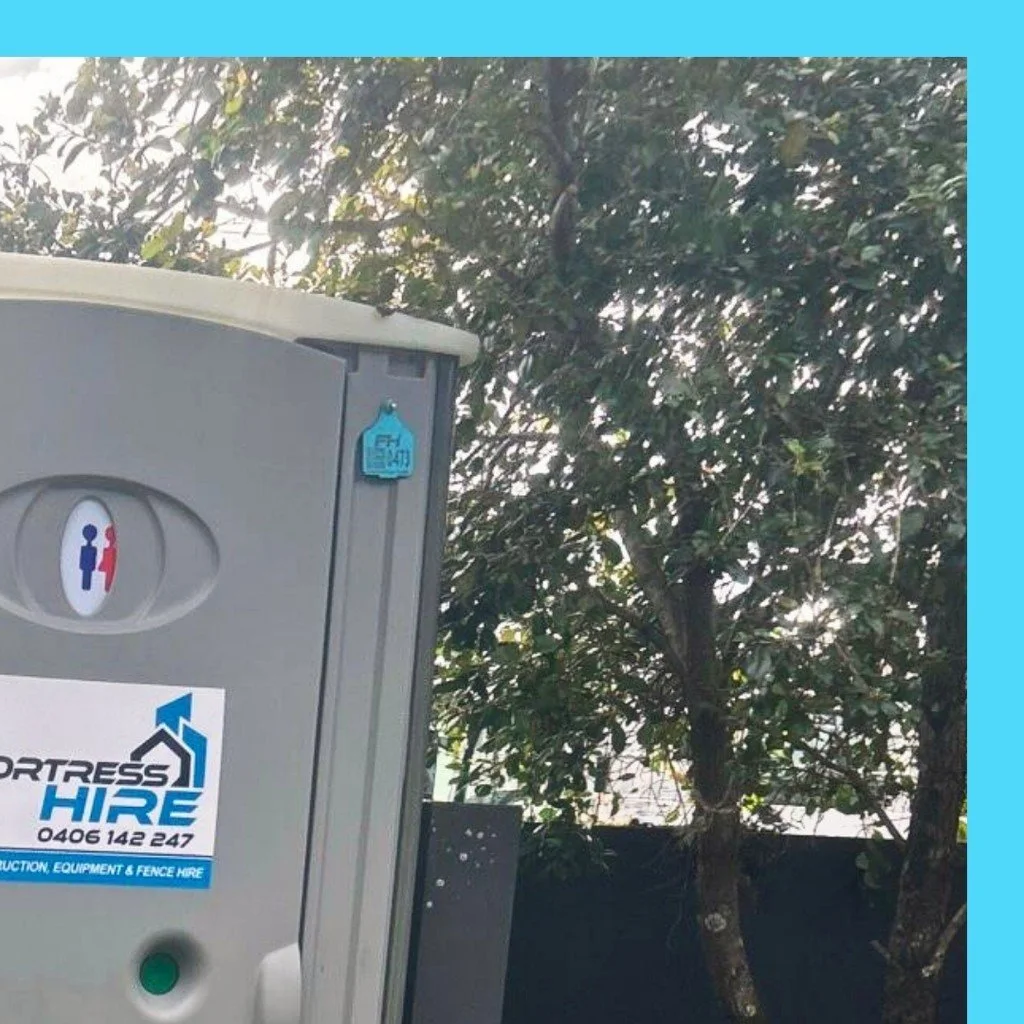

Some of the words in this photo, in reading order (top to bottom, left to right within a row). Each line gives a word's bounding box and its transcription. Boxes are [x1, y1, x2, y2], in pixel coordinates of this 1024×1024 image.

[39, 784, 204, 827] HIRE
[37, 827, 100, 844] 0406
[107, 830, 145, 846] 142
[150, 832, 194, 848] 247
[53, 861, 122, 876] EQUIPMENT
[125, 864, 134, 876] &
[136, 865, 174, 878] FENCE
[176, 867, 205, 879] HIRE
